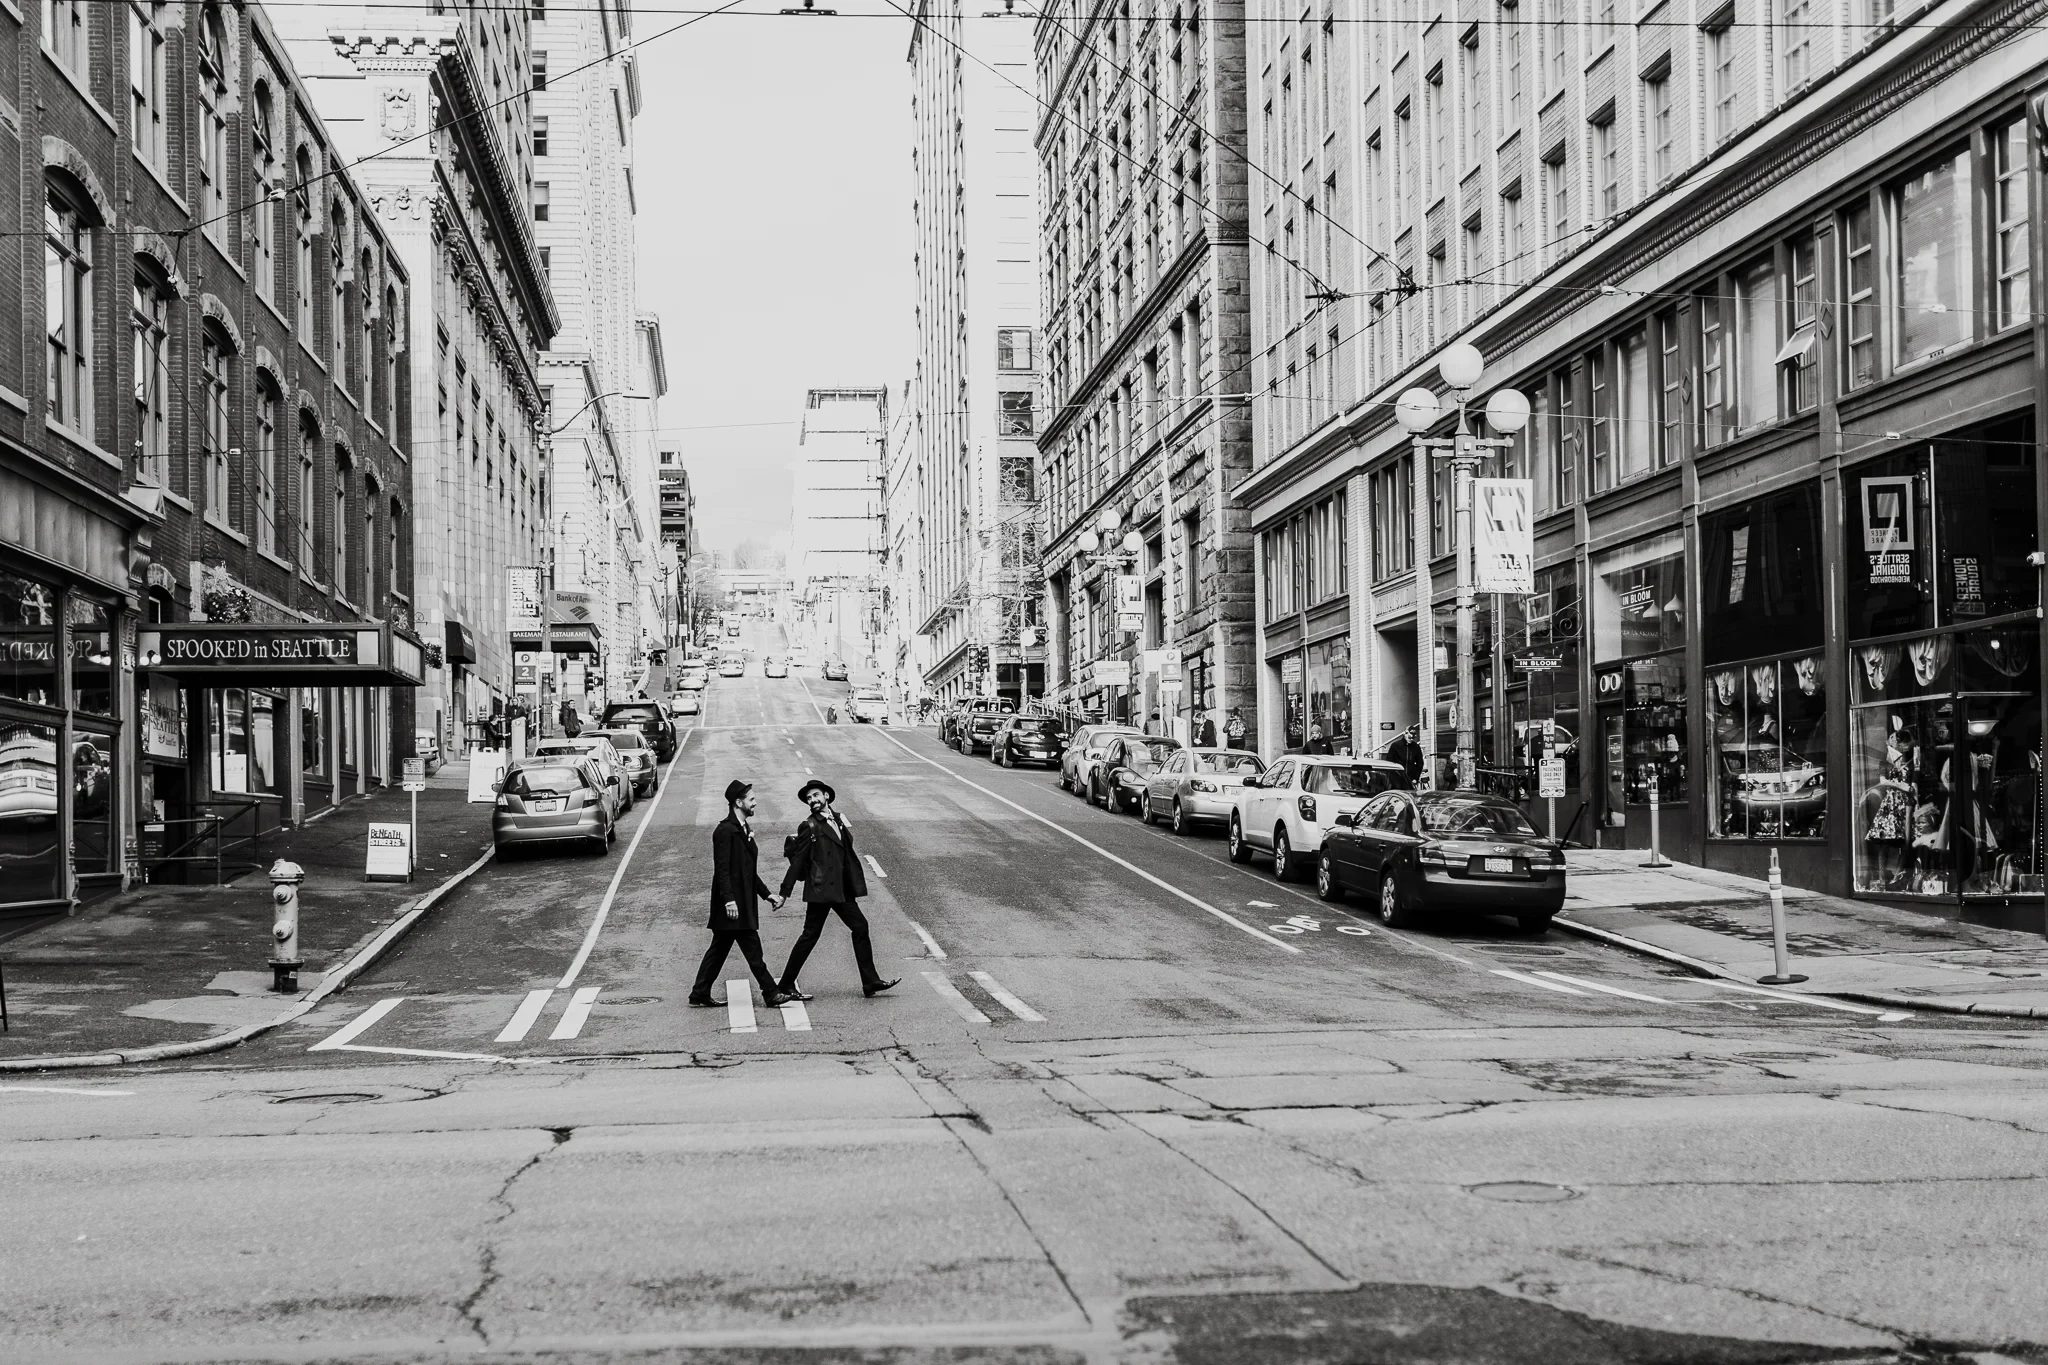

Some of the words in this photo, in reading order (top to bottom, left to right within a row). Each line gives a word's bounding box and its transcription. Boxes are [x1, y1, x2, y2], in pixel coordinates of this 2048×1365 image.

[556, 593, 572, 602] Bank
[1622, 595, 1629, 606] IN
[1630, 590, 1651, 604] BLOOM
[167, 639, 251, 659] SPOOKED
[254, 639, 268, 658] in
[271, 638, 351, 658] SEATTLE
[521, 666, 530, 677] 2
